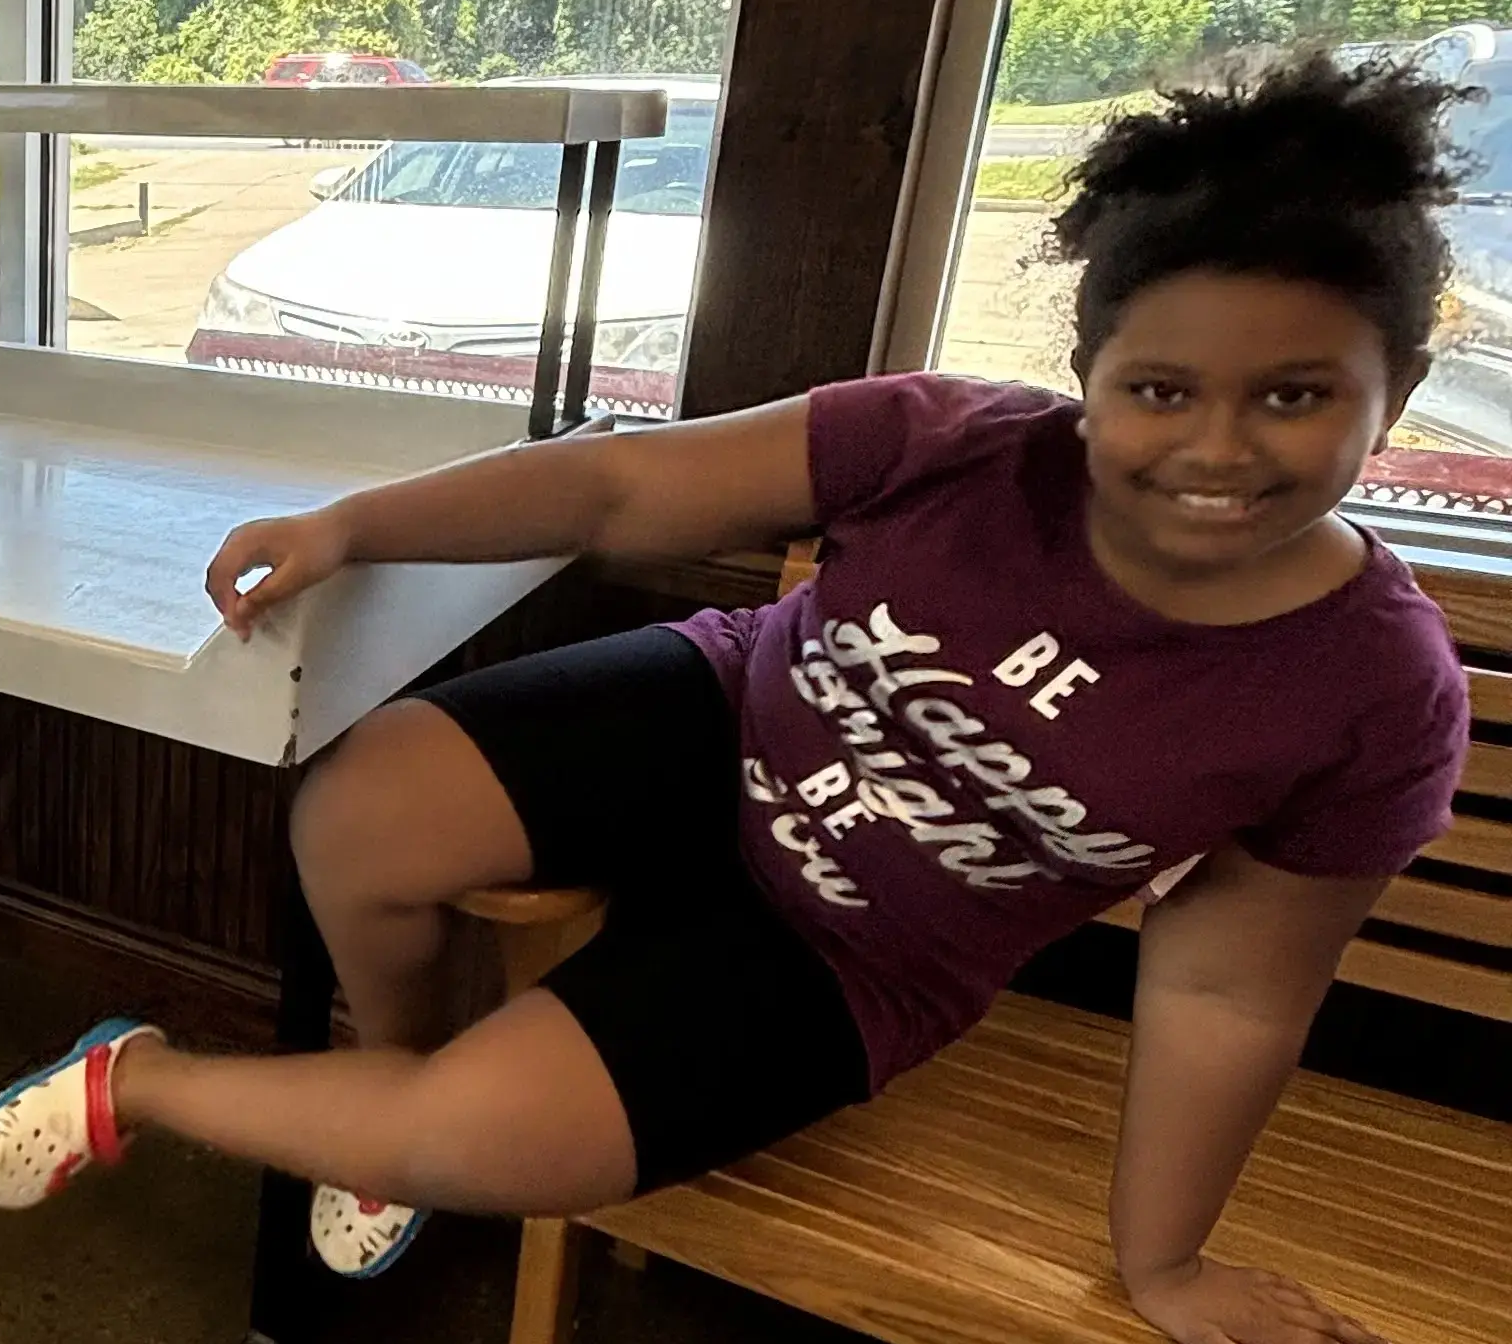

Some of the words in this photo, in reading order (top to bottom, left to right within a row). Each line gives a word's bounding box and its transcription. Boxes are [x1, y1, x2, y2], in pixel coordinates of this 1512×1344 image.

[991, 631, 1100, 721] BE
[824, 602, 1155, 884] Happy
[796, 760, 877, 841] BE
